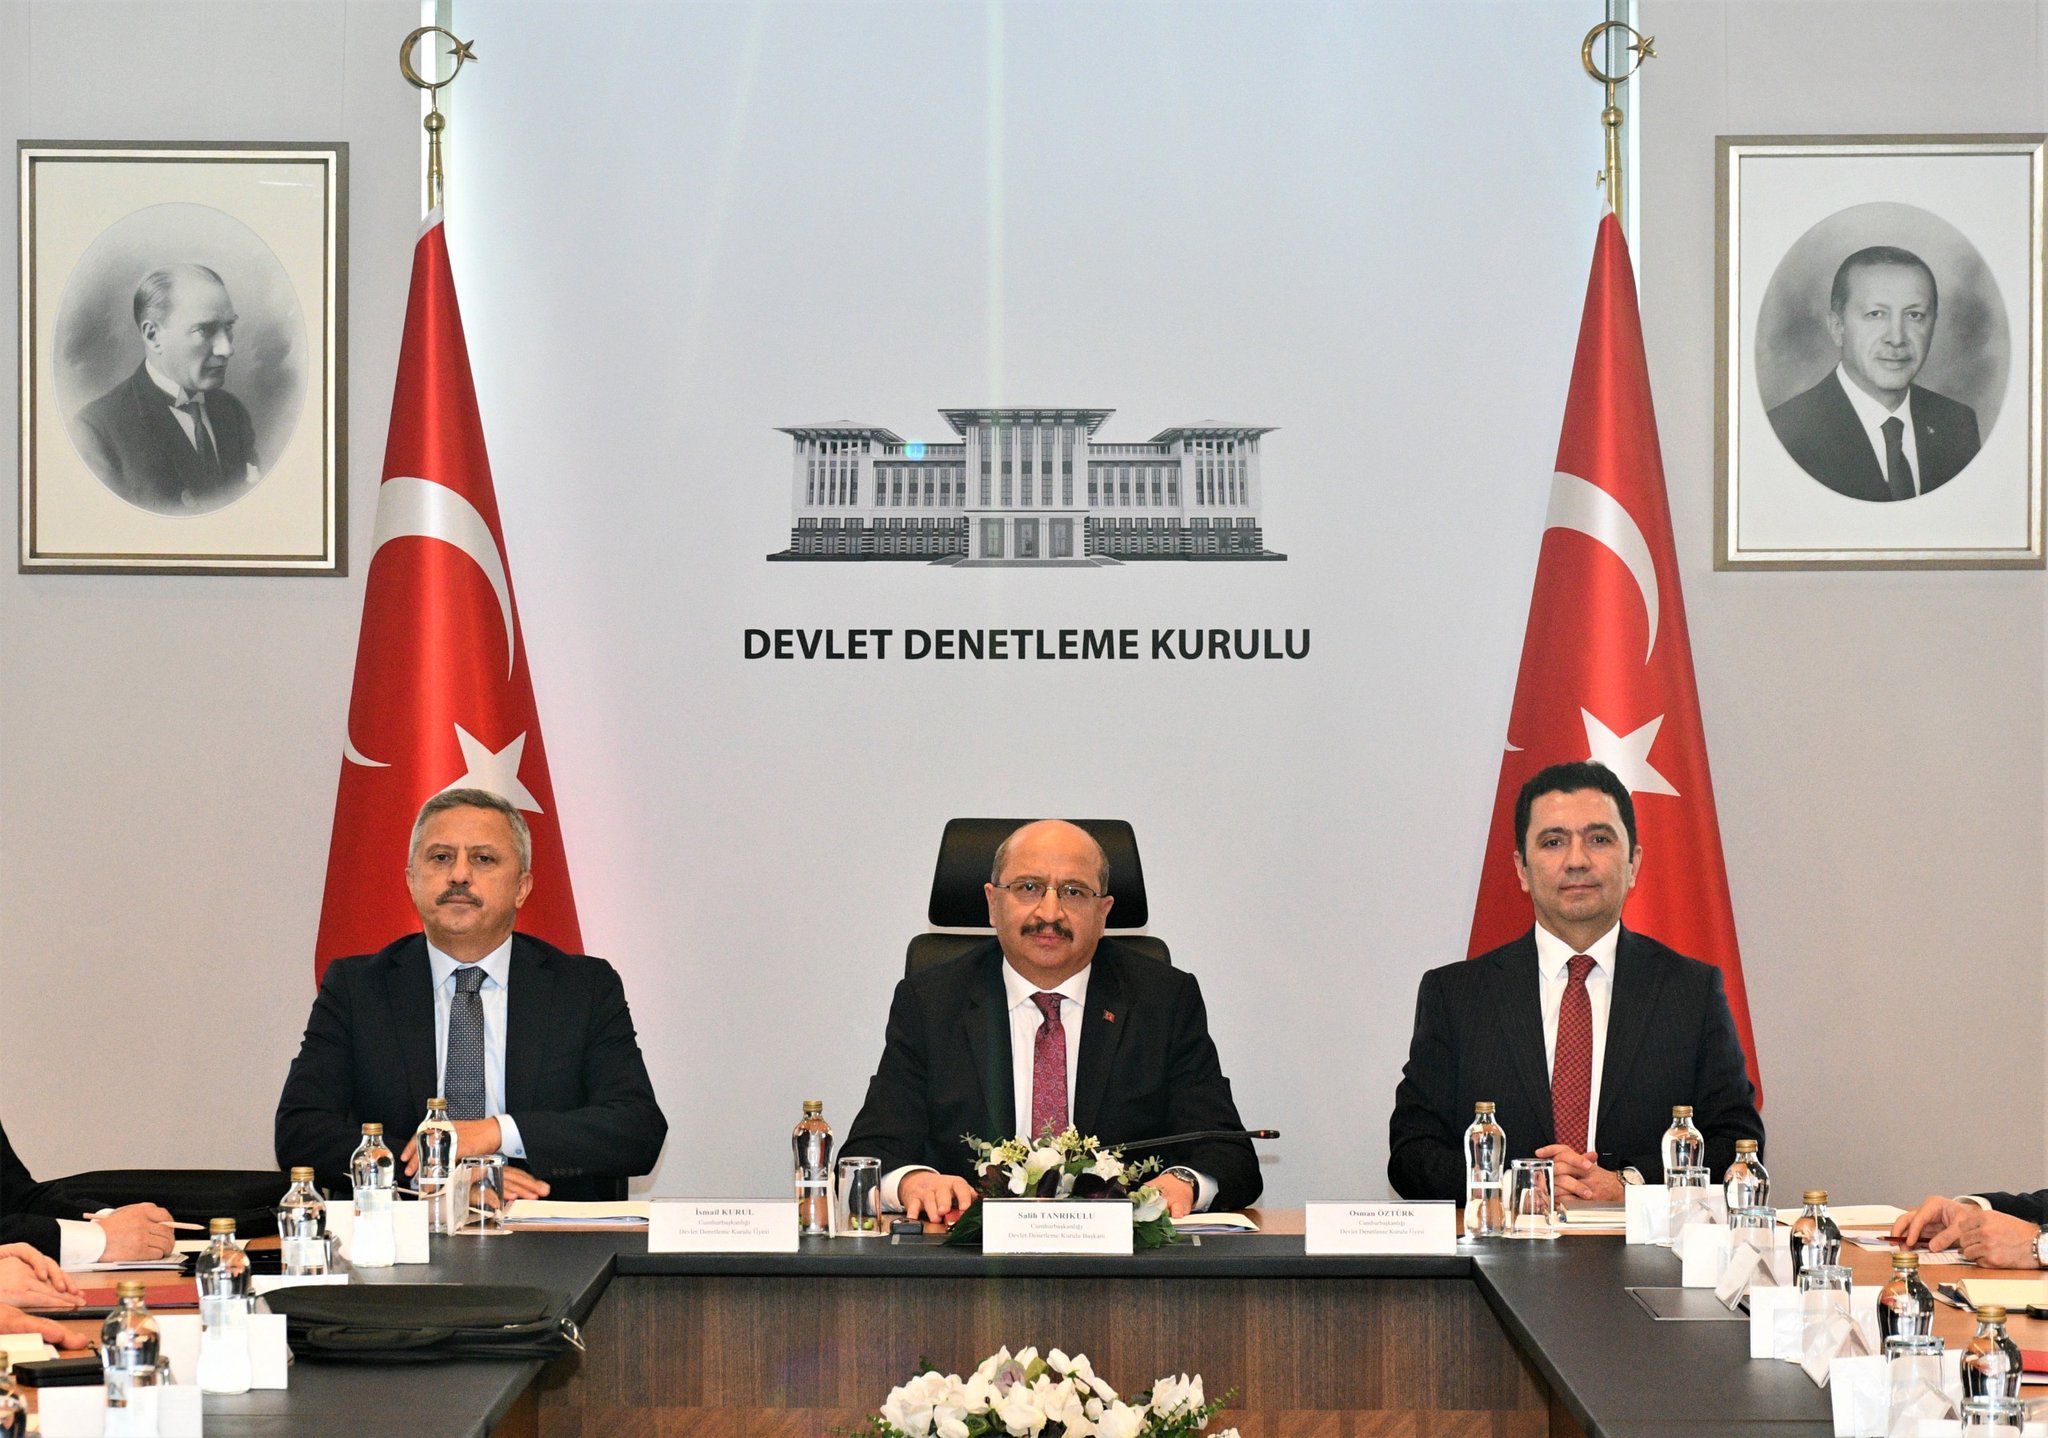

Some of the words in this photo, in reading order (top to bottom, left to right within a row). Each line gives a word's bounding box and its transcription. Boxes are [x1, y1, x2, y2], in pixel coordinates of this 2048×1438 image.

[745, 629, 892, 659] DEVLET
[905, 629, 1138, 659] DENETLEME
[1152, 629, 1309, 660] KURULU
[695, 1207, 720, 1216] İsmail
[721, 1208, 755, 1216] KURUL
[1017, 1211, 1038, 1220] Salih
[1041, 1212, 1096, 1220] TANRIKULU
[1349, 1209, 1376, 1217] Osman
[1377, 1208, 1415, 1217] ÖZTÜRK
